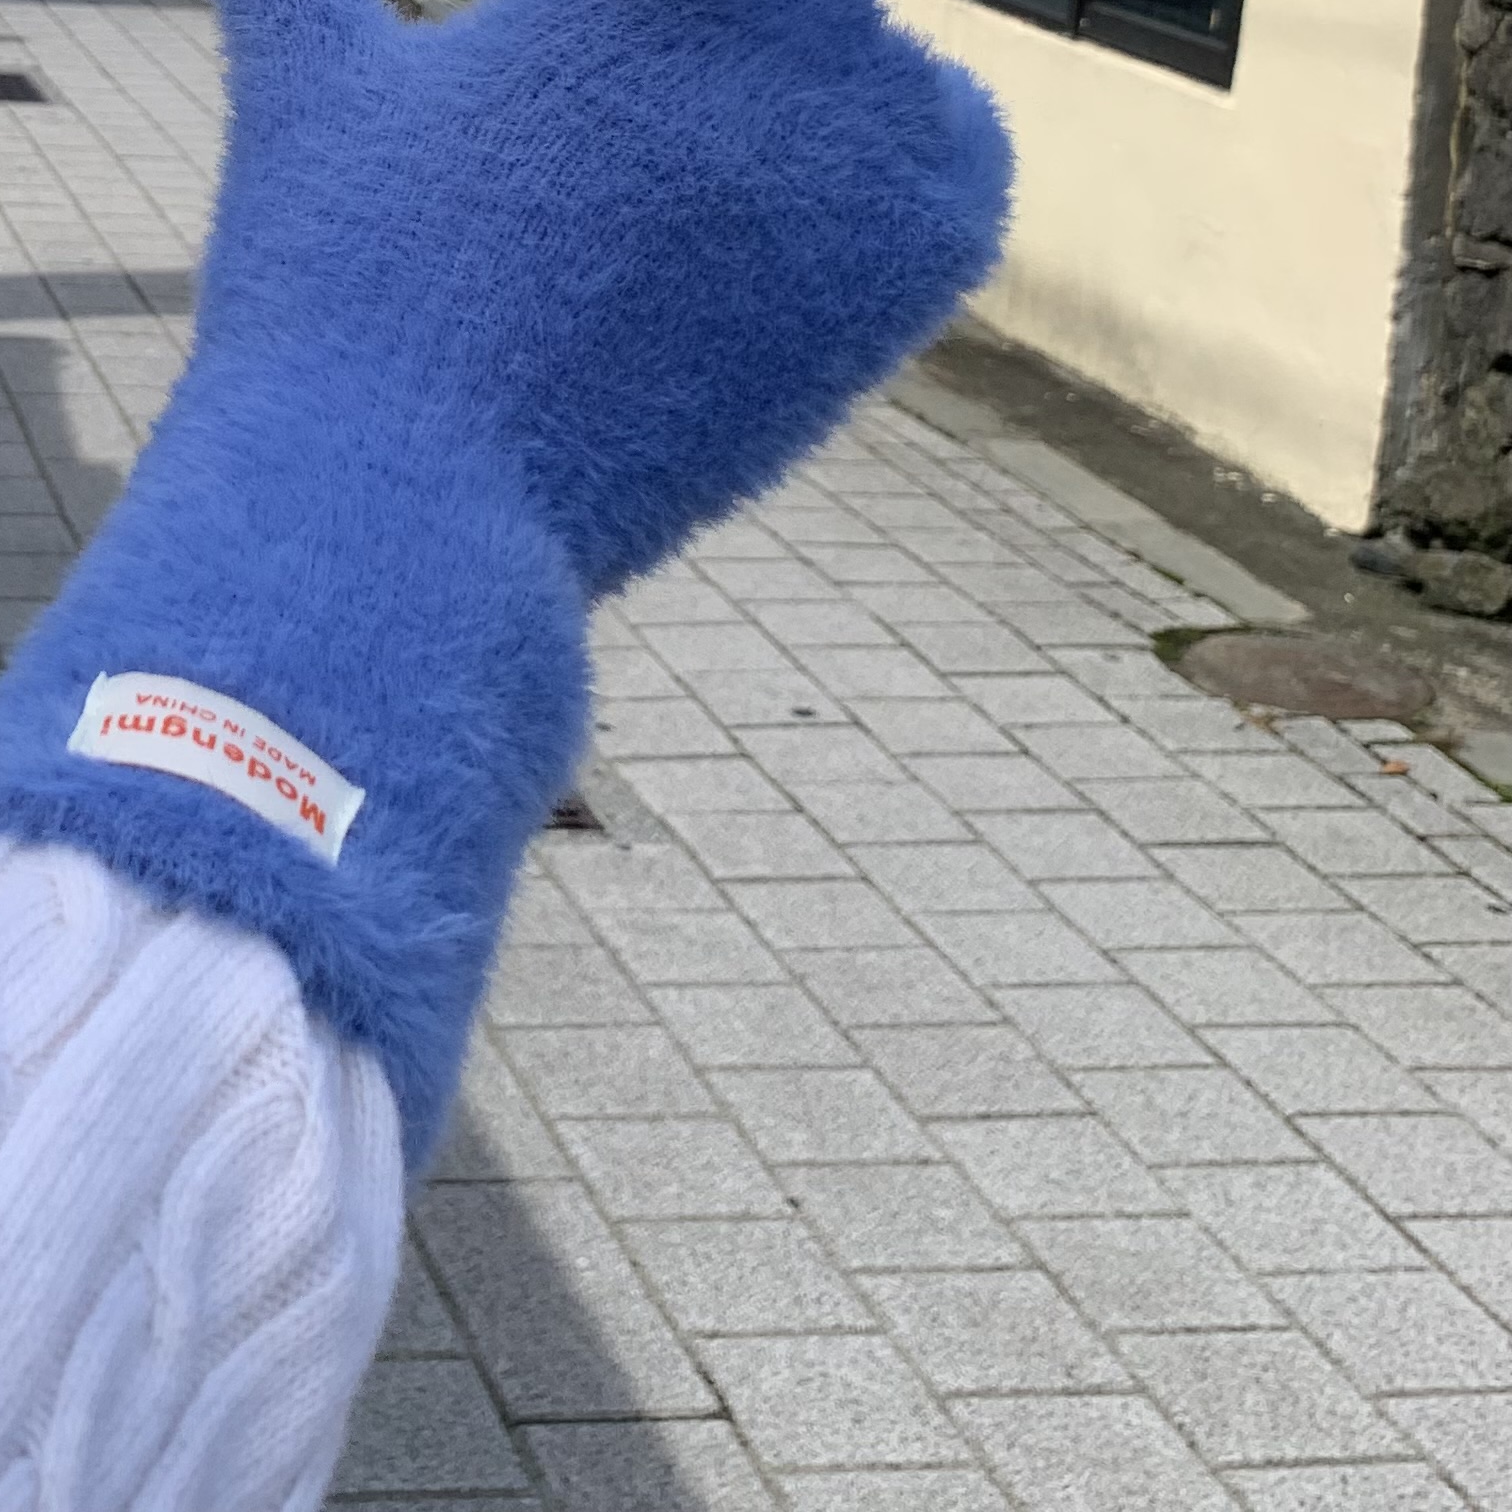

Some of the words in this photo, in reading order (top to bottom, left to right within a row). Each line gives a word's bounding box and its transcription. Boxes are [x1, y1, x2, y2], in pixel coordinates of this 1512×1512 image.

[135, 692, 217, 721] CHINA
[223, 718, 247, 737] IN
[99, 713, 327, 836] Modengmi
[251, 734, 317, 786] MADE
